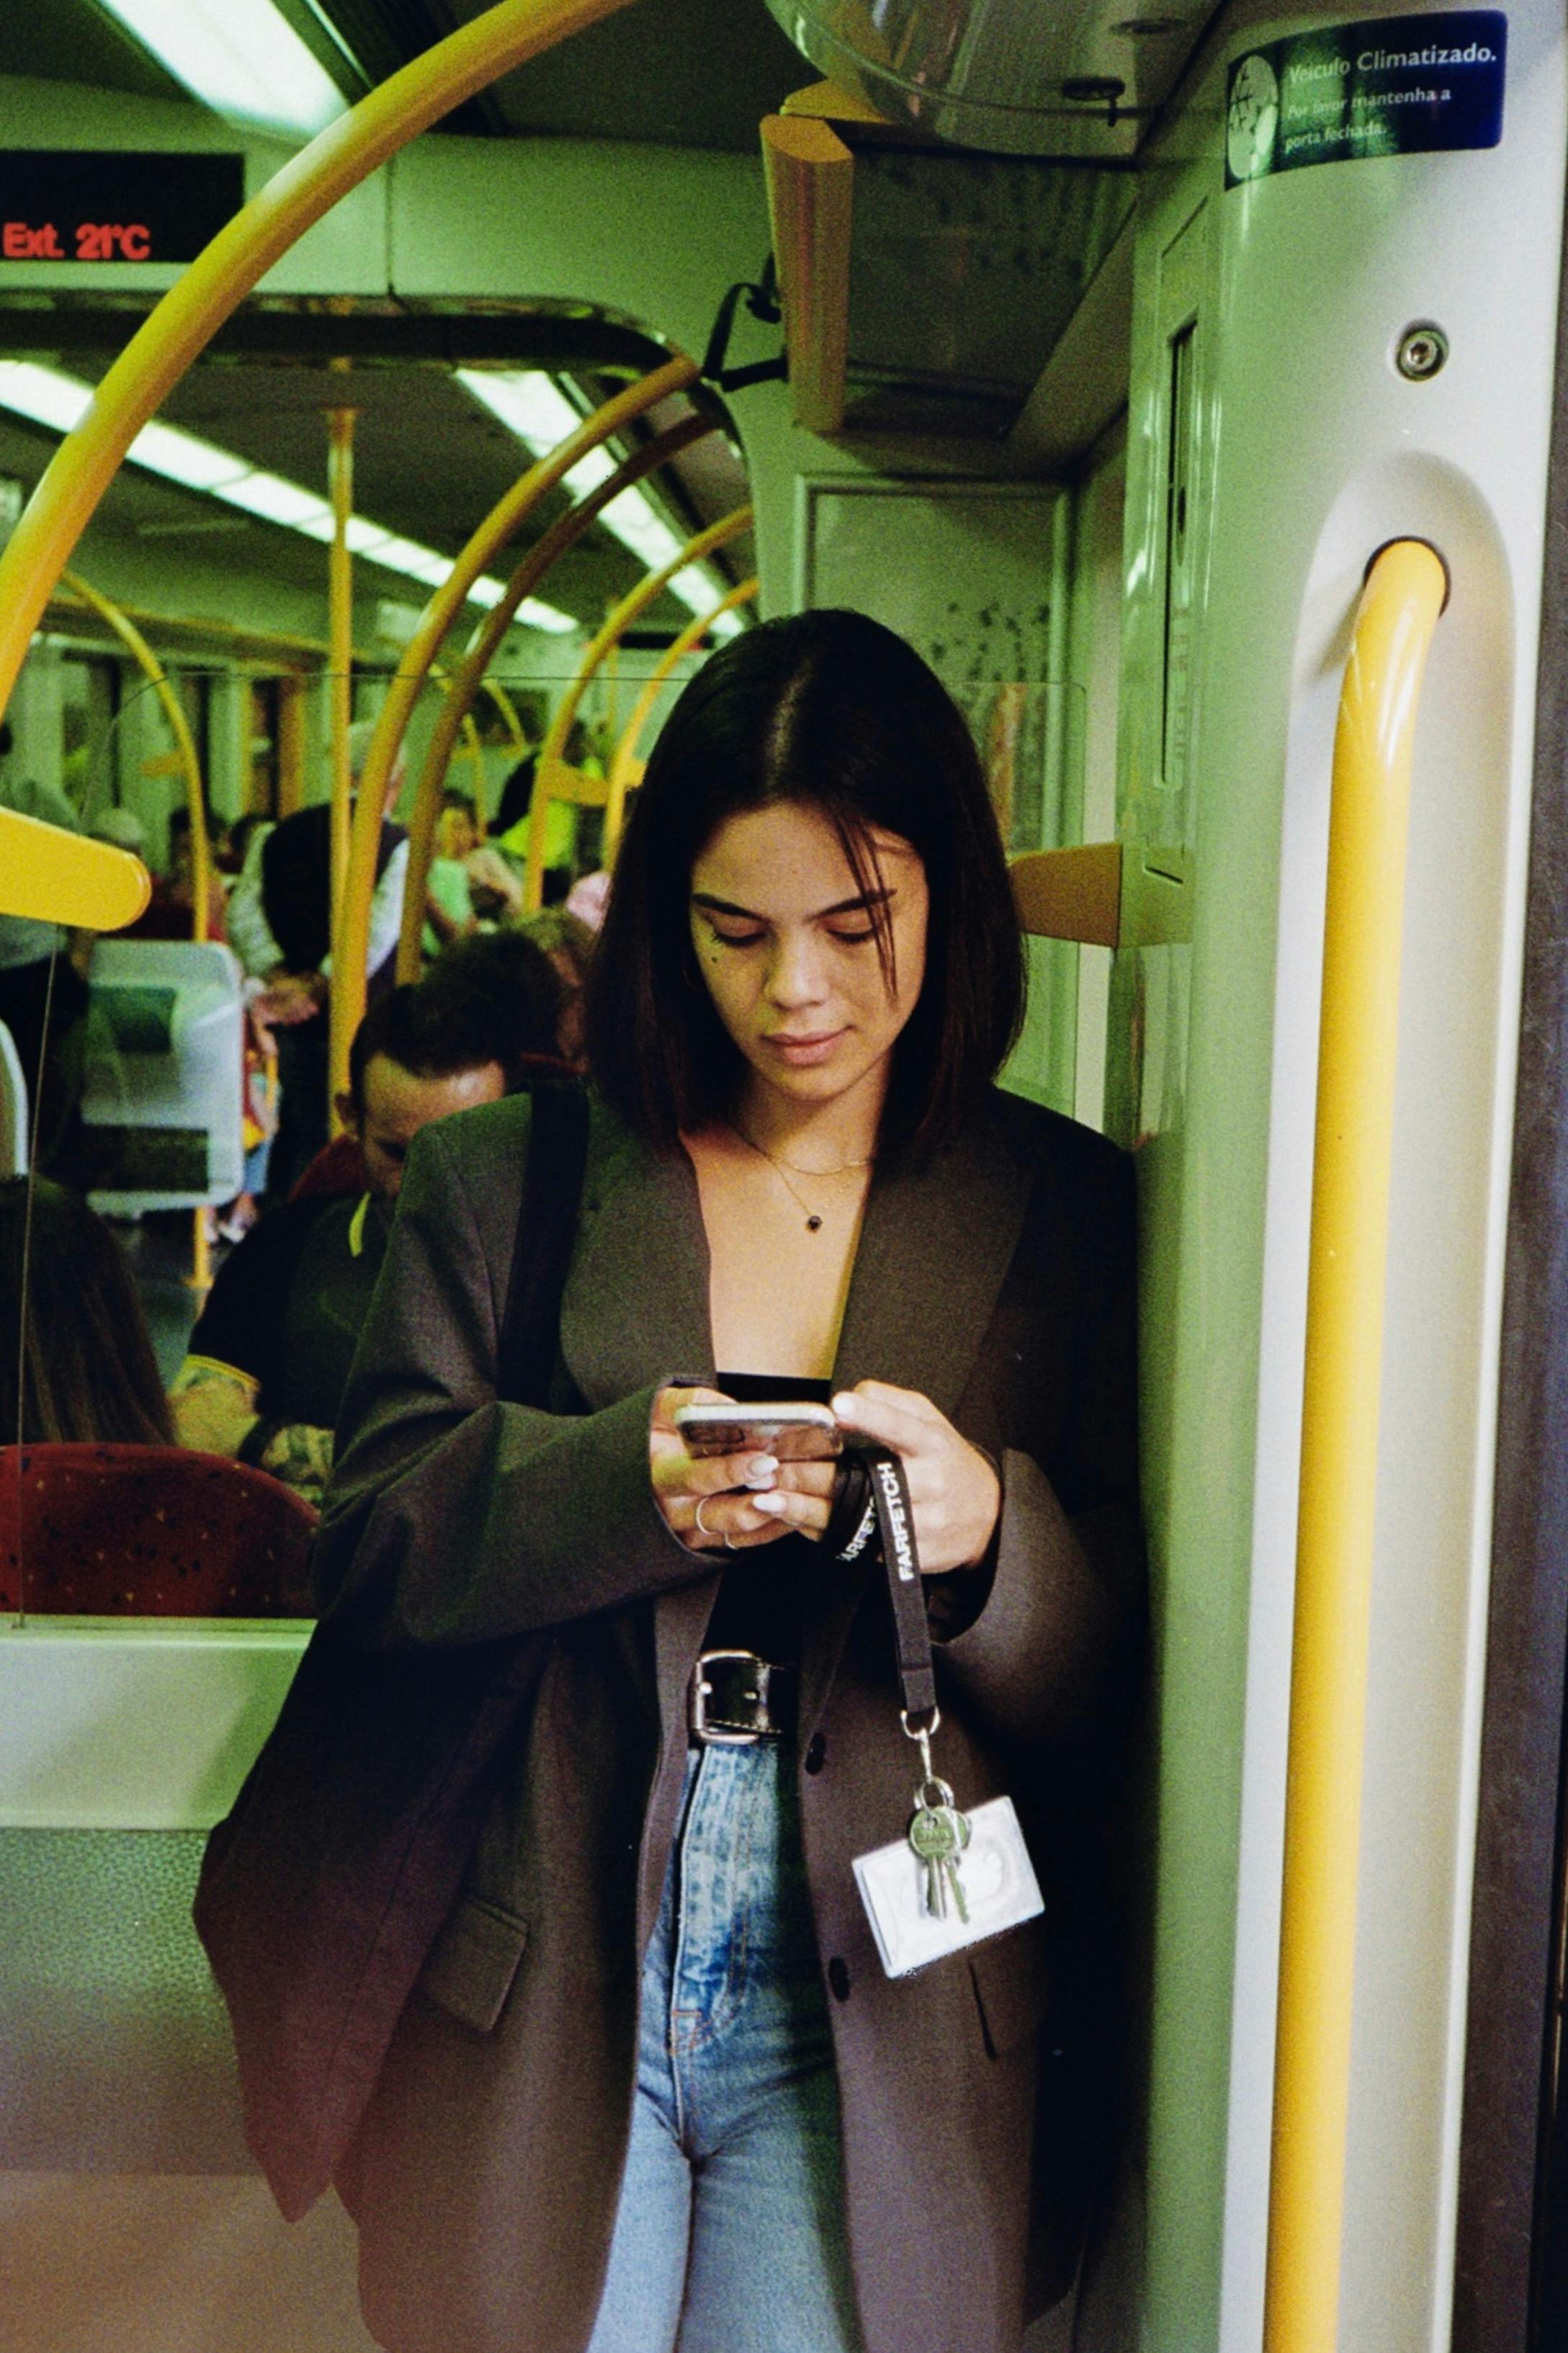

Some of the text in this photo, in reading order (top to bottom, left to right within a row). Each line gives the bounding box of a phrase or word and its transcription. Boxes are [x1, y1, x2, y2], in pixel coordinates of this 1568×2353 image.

[1357, 42, 1497, 71] Climatizado.
[1351, 86, 1436, 109] mantenha
[1438, 89, 1451, 101] a
[1286, 133, 1321, 155] porta
[836, 1495, 876, 1562] ARFET
[877, 1463, 915, 1581] FARFETCH
